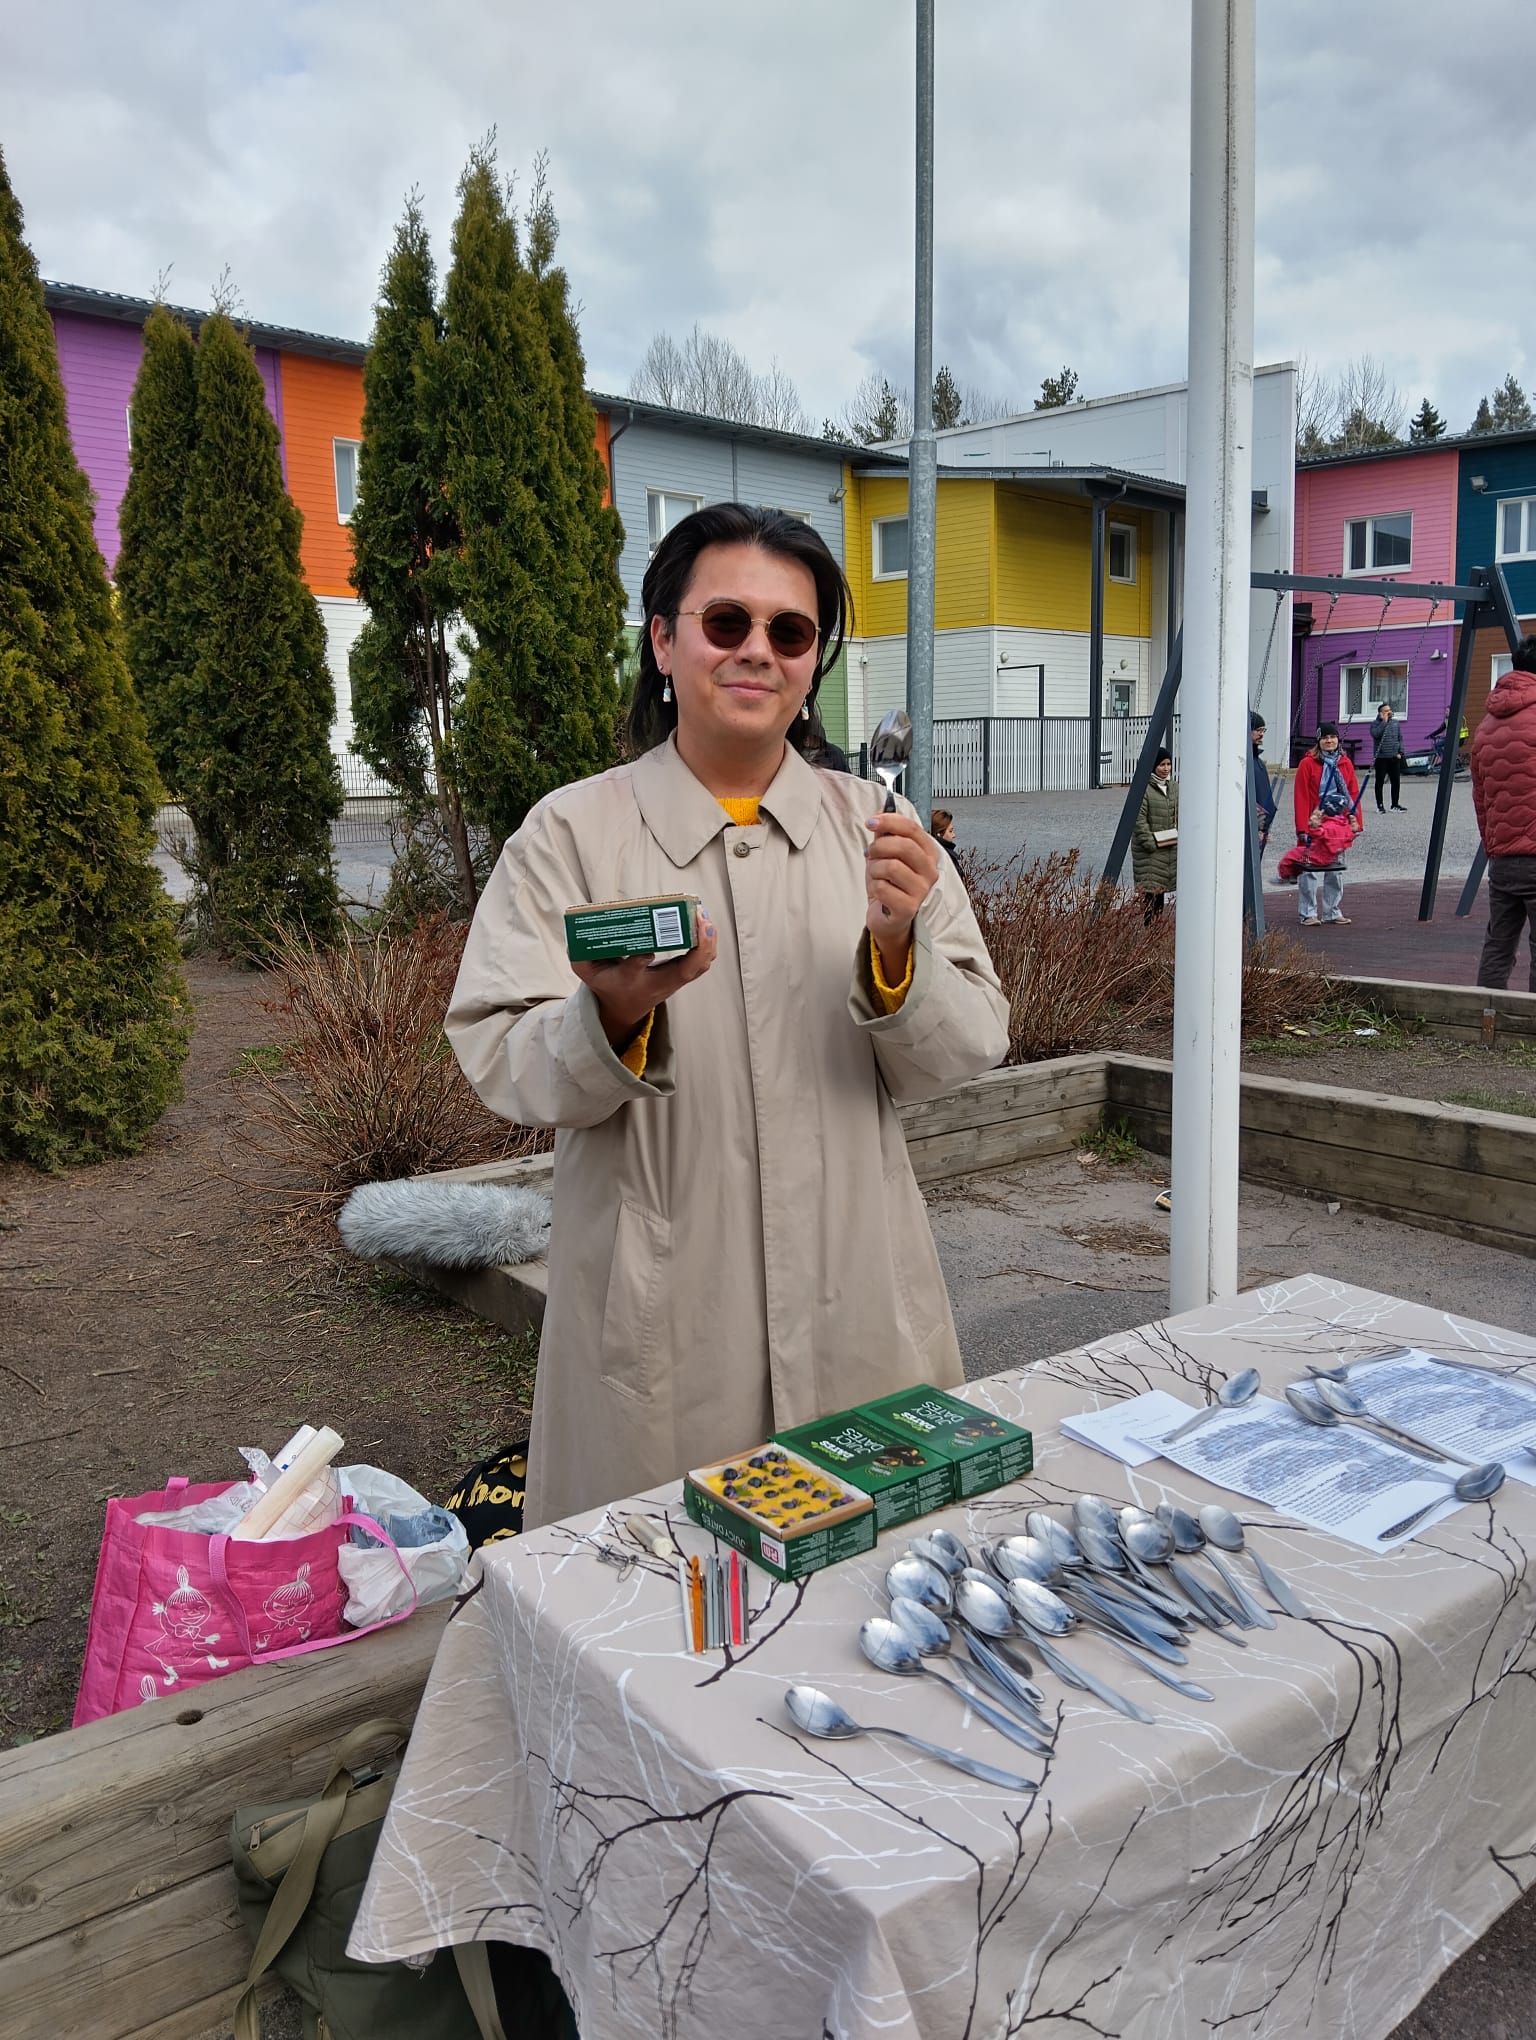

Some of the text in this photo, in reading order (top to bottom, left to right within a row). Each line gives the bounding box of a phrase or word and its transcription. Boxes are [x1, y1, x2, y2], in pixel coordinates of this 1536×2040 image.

[911, 1407, 952, 1425] JUICY
[922, 1401, 964, 1422] DATES
[830, 1435, 871, 1454] JUICY
[842, 1428, 885, 1451] DATES
[702, 1513, 746, 1549] JUICY DATES
